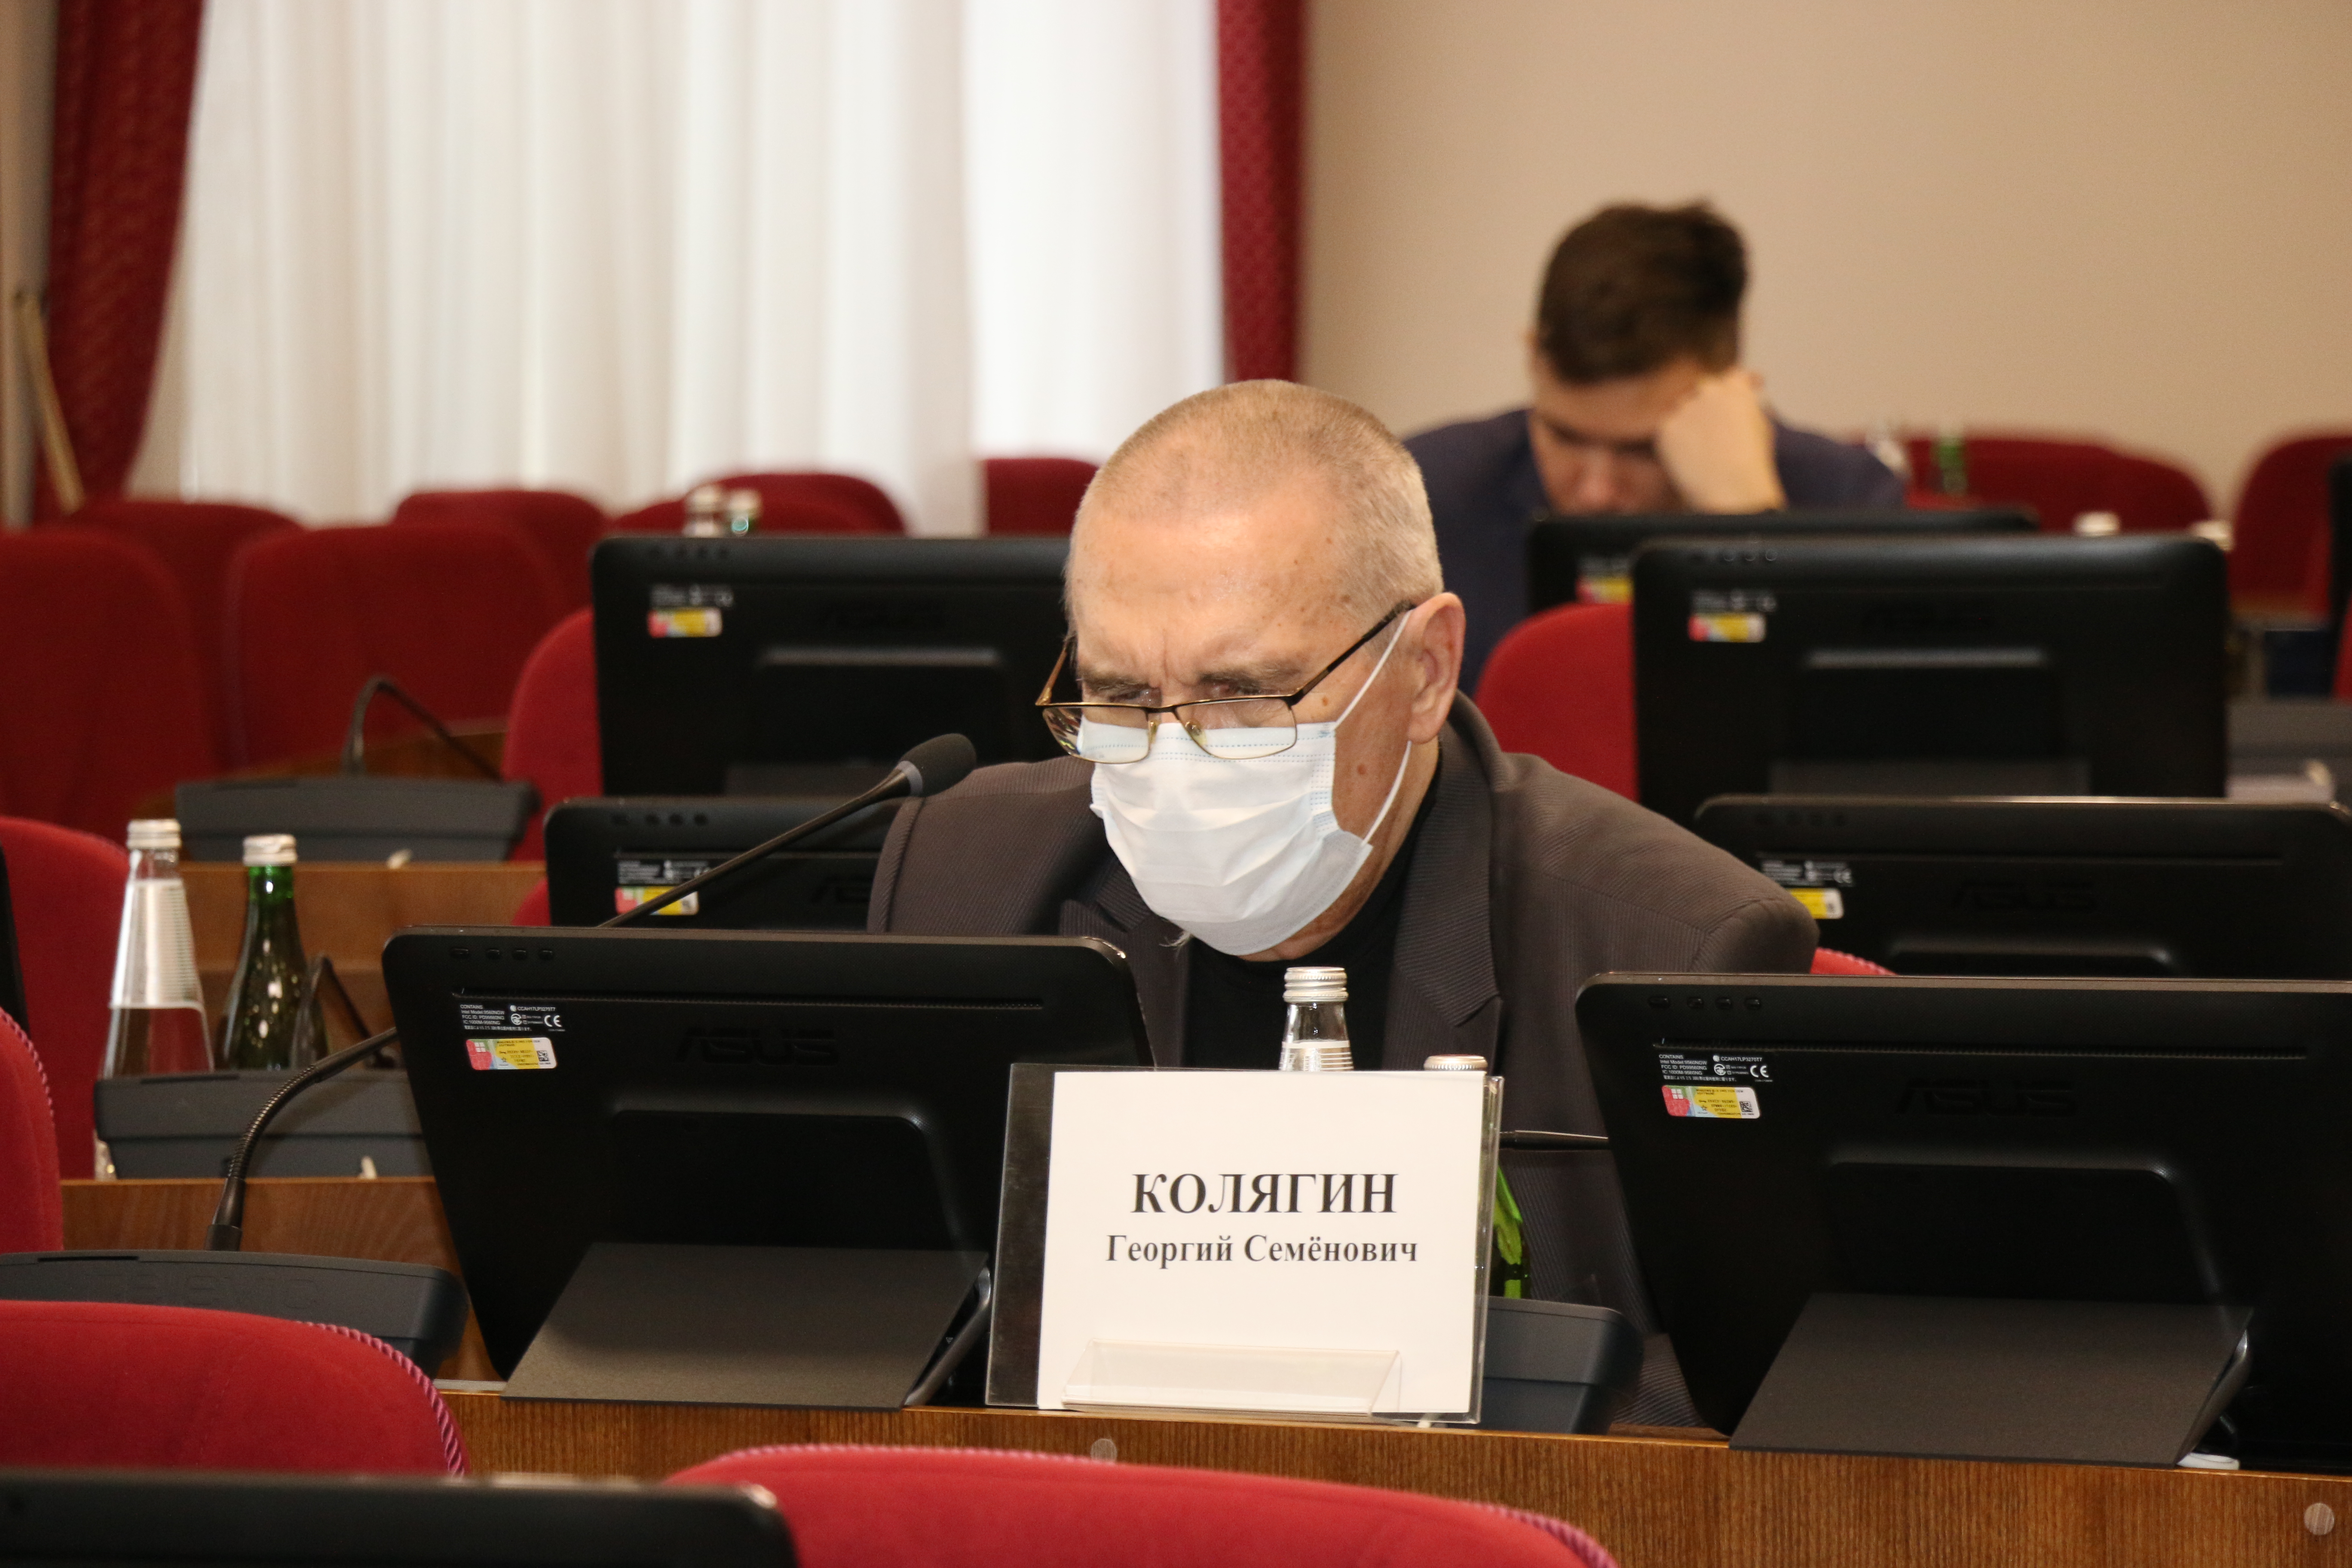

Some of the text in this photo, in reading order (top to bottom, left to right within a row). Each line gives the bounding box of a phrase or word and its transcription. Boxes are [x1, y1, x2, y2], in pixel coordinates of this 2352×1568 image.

[675, 1027, 839, 1065] ASUS
[1896, 1077, 2076, 1116] ASUS
[1131, 1173, 1398, 1213] КОЛЯГИН
[1106, 1235, 1418, 1269] Георгий Семёнович
